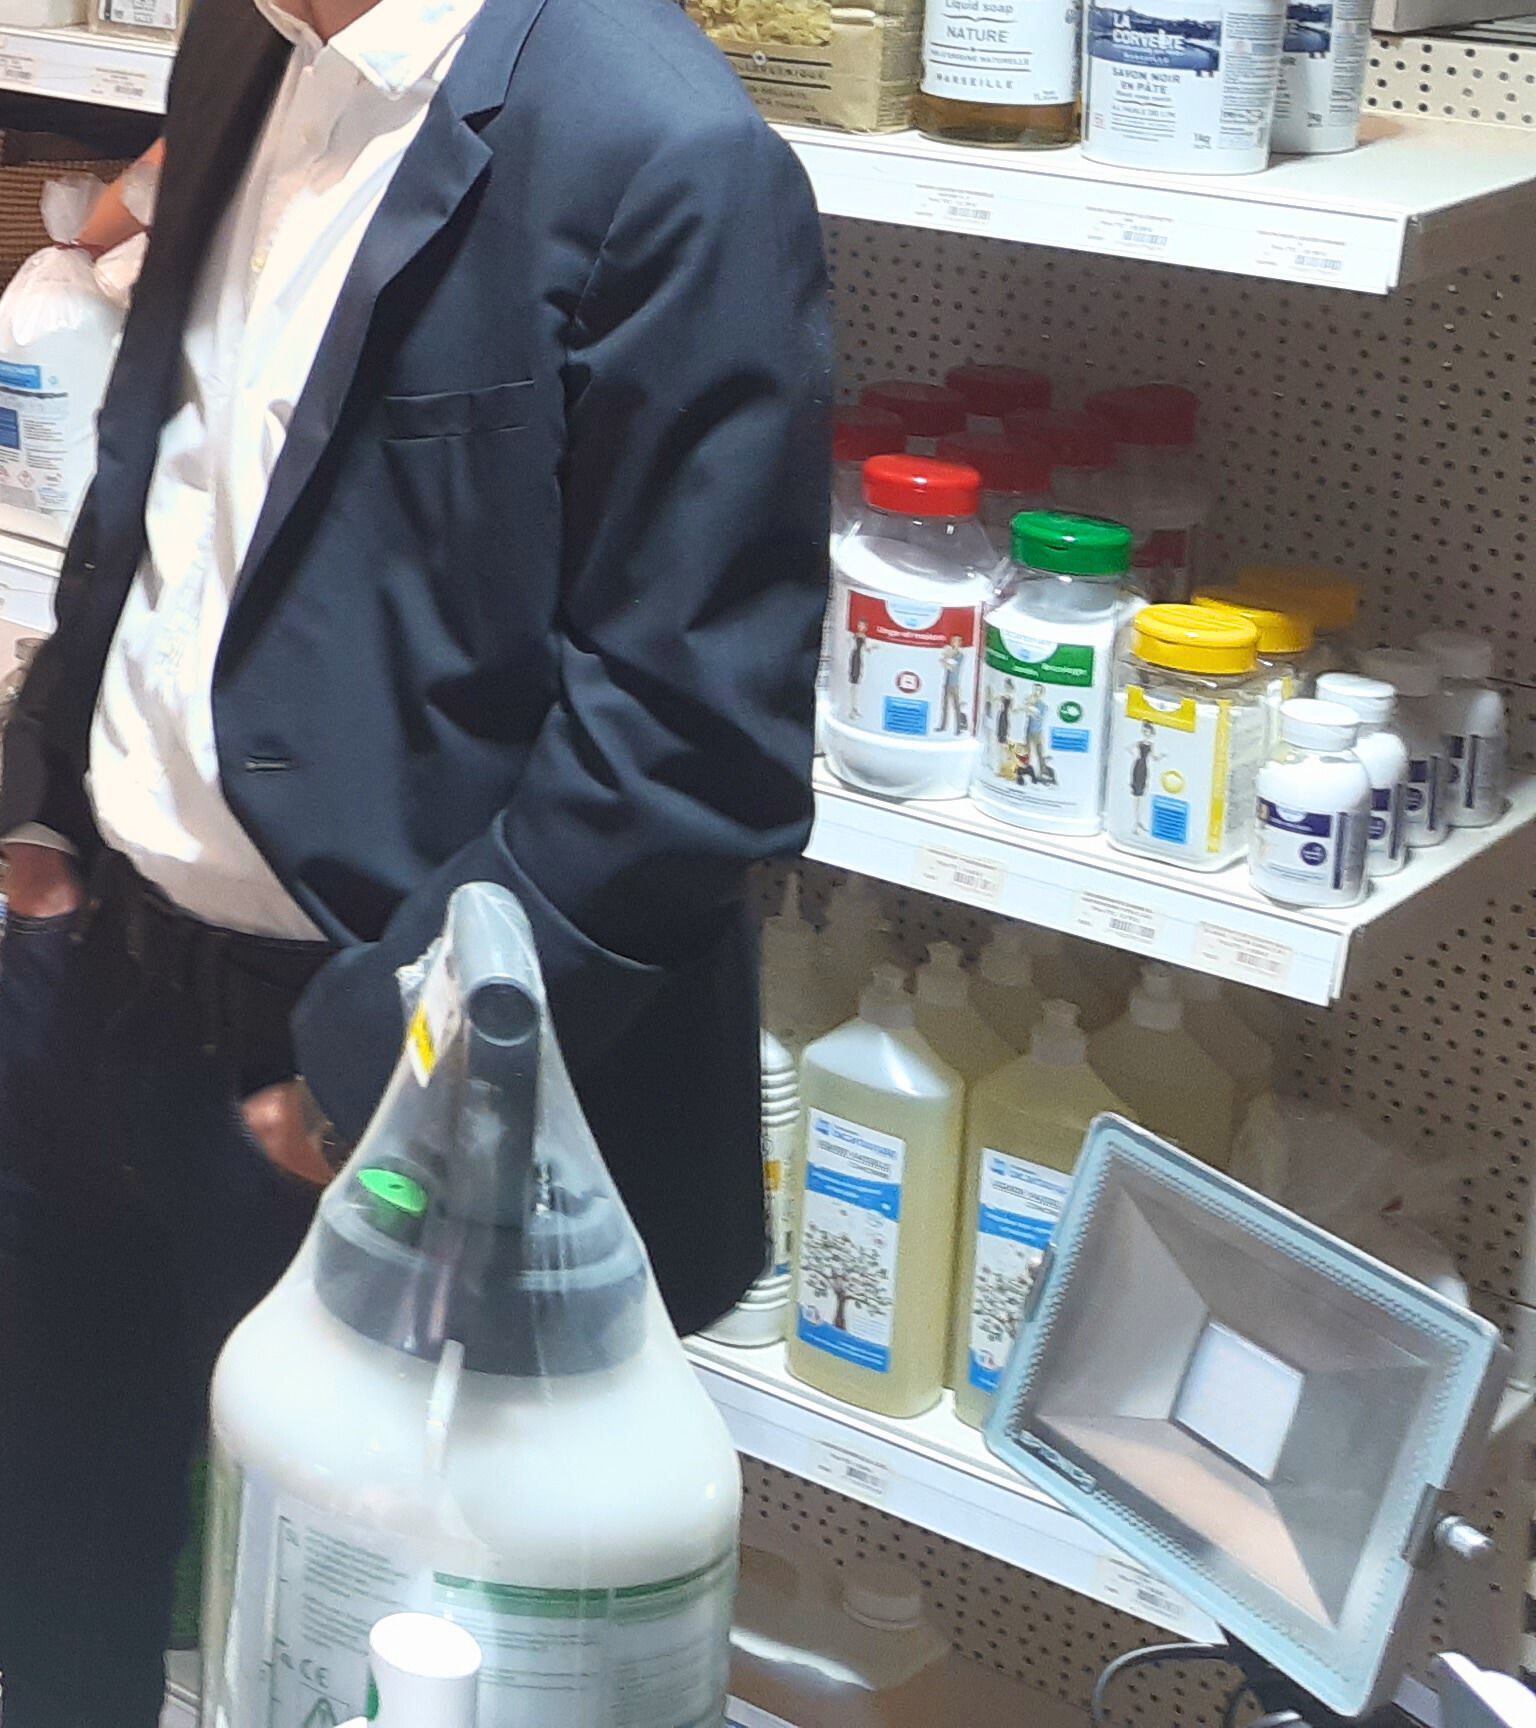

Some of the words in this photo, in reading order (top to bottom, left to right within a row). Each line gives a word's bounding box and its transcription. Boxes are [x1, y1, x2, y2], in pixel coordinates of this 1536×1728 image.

[982, 2, 1014, 15] soap
[1113, 13, 1132, 30] LA
[945, 25, 1010, 44] NATURE
[936, 72, 1015, 90] MARSEILLE
